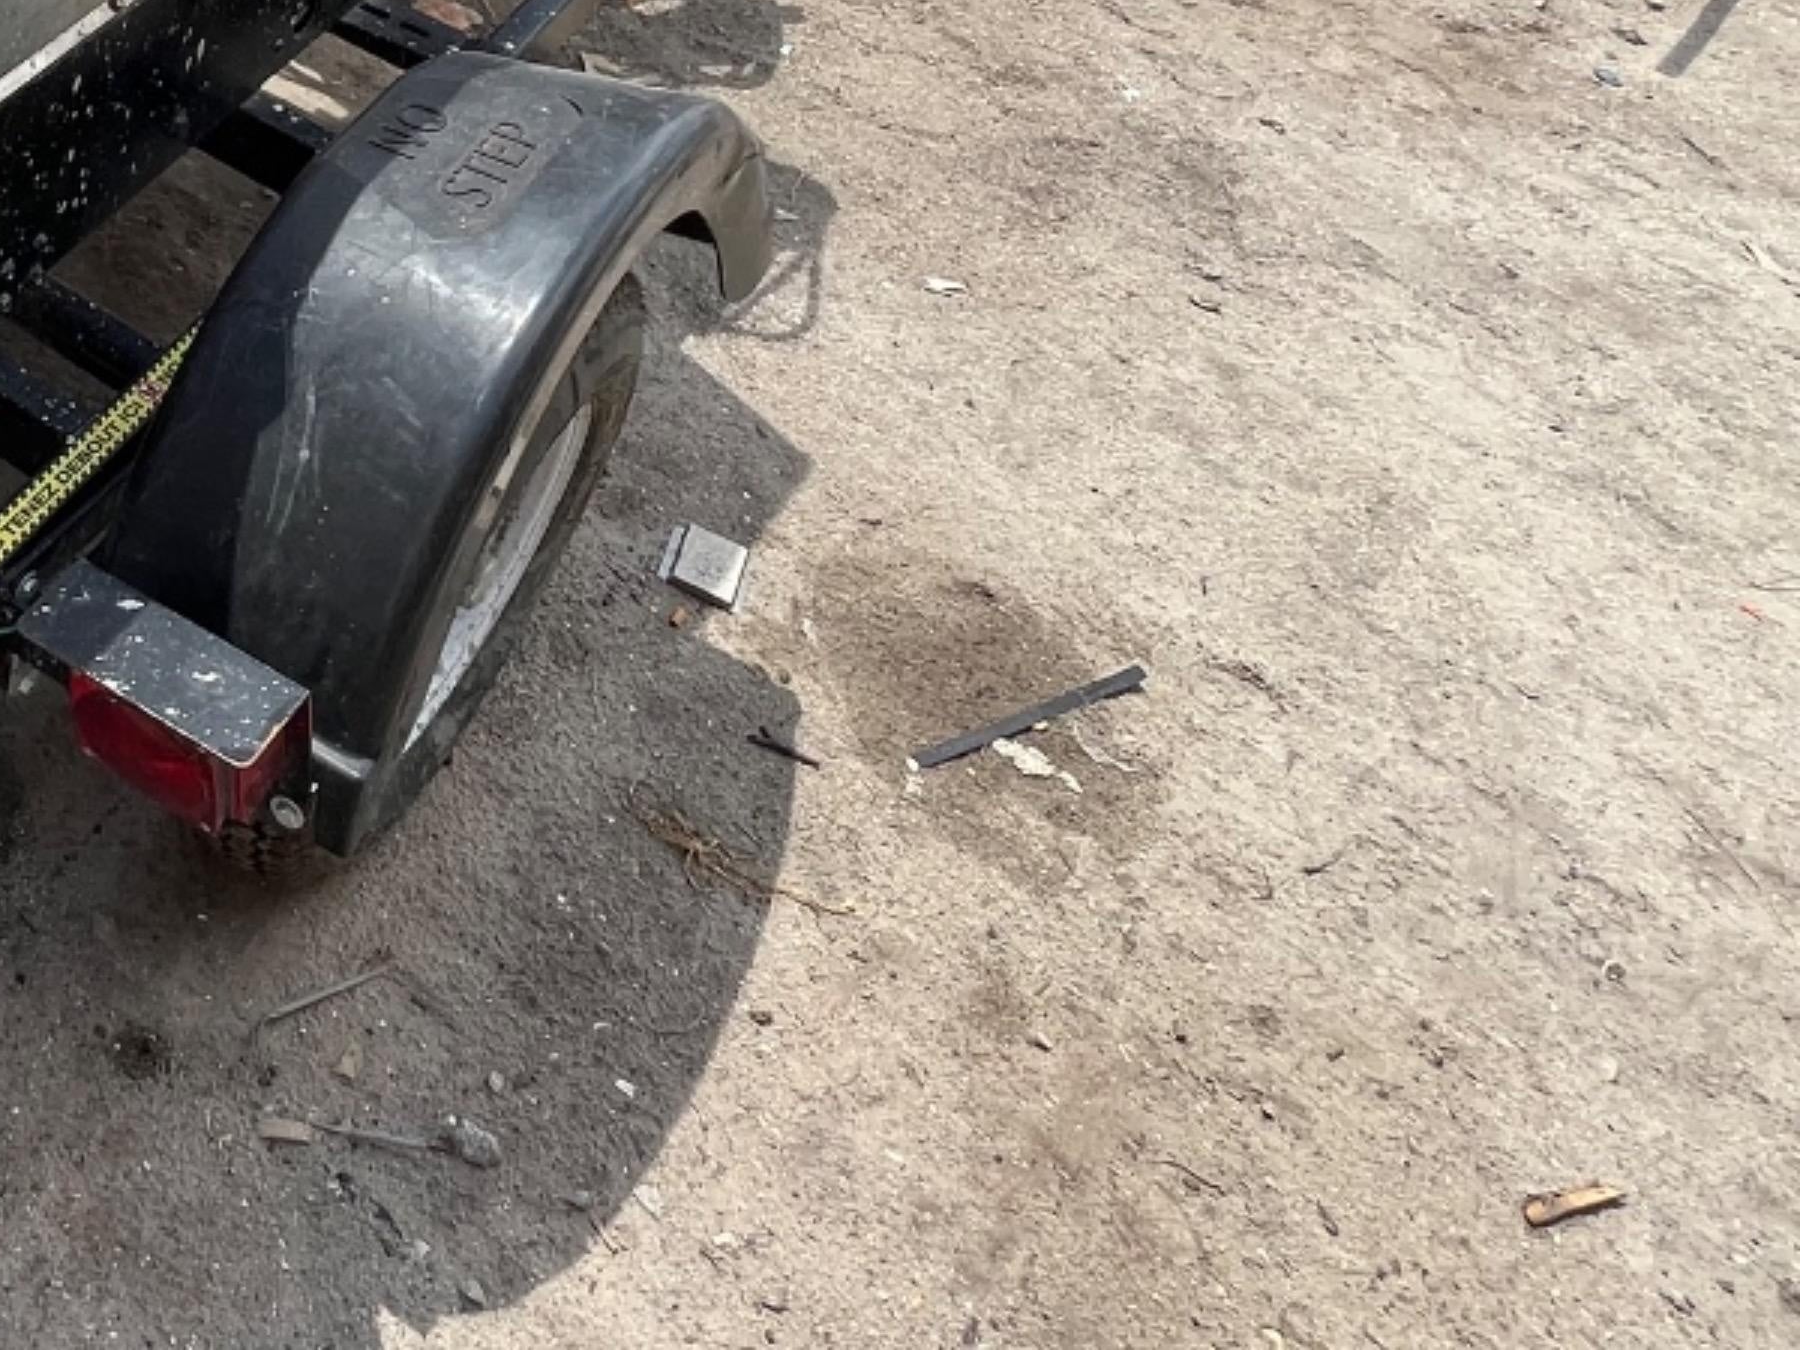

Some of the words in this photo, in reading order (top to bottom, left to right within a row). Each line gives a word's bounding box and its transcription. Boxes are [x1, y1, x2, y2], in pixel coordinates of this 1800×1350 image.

[442, 121, 538, 208] STEP
[0, 481, 60, 535] TENEZ
[55, 419, 121, 484] DEBOUT
